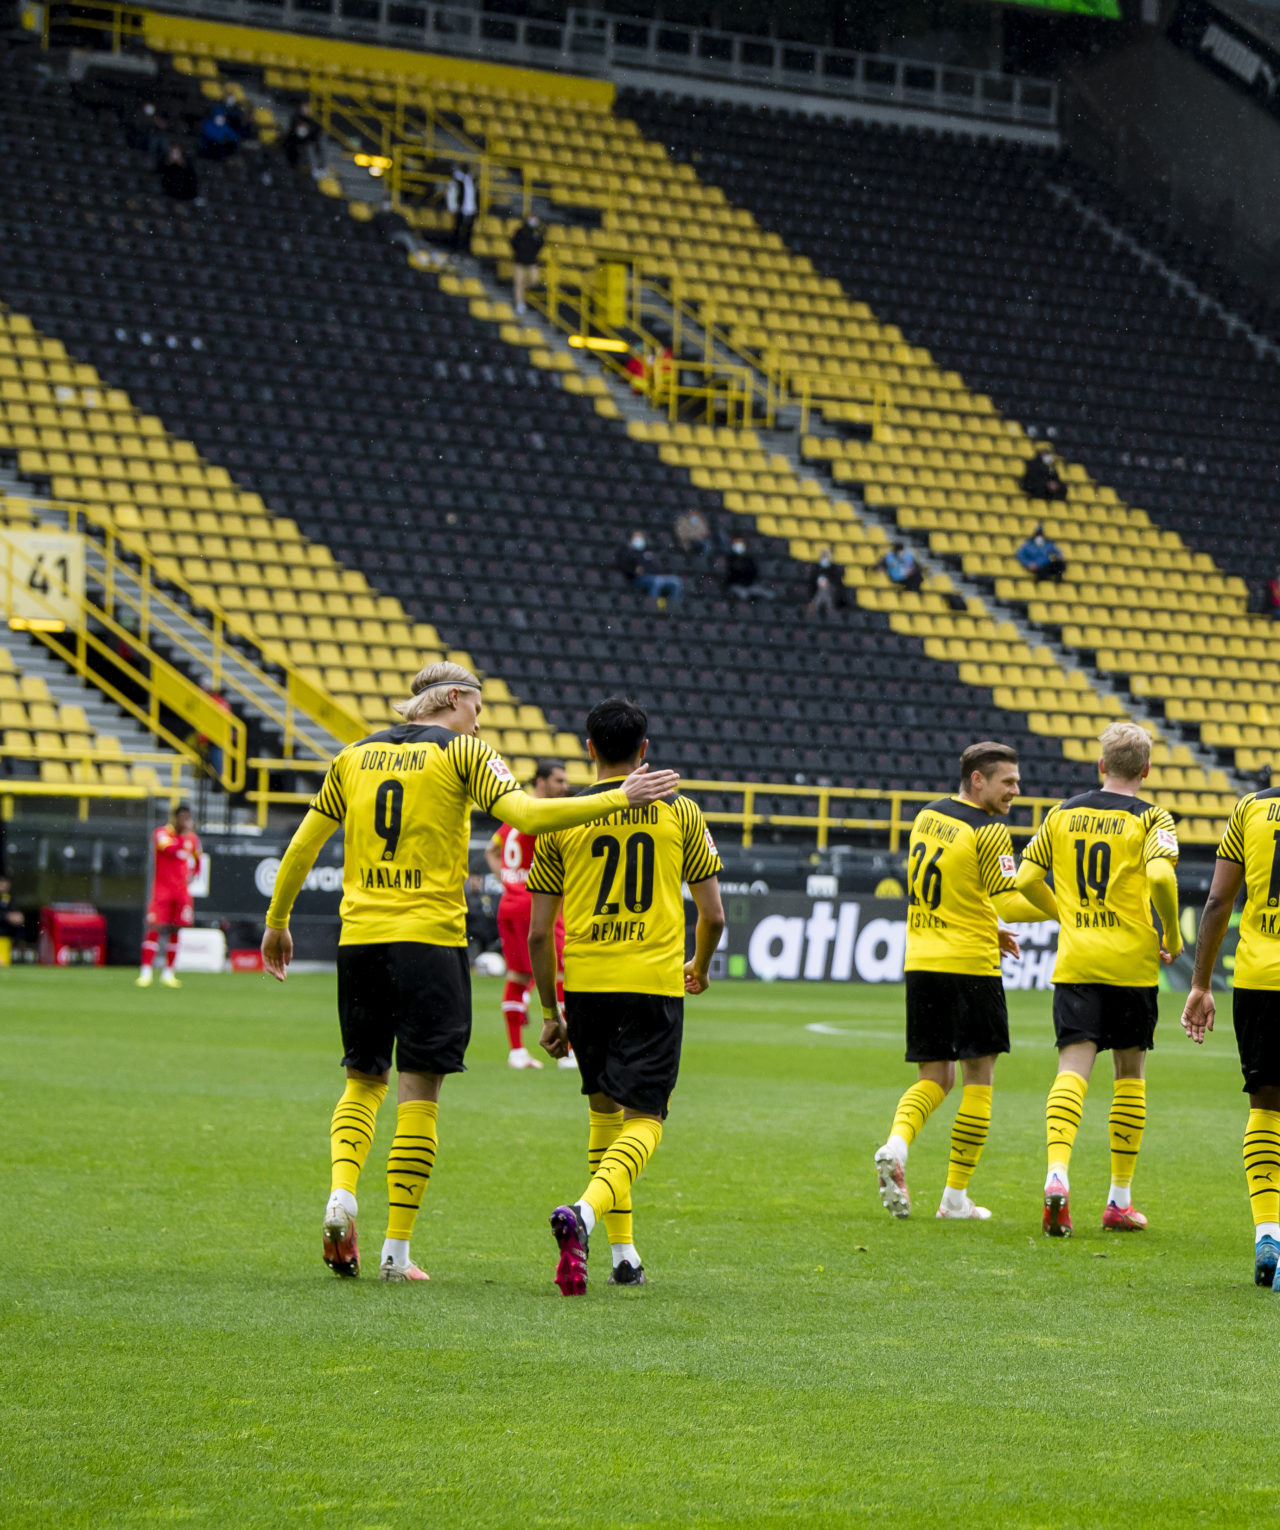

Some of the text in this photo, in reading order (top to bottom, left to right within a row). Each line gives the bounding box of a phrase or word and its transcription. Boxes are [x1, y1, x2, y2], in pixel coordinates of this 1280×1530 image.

[28, 553, 69, 598] 41
[360, 750, 427, 772] DORTMUND
[374, 779, 404, 862] 9
[917, 815, 960, 844] DORTMUND
[1069, 815, 1126, 835] DORTMUND
[503, 828, 523, 869] 6
[592, 832, 655, 917] 20
[908, 841, 945, 911] 26
[1074, 839, 1112, 908] 19
[748, 901, 906, 983] atla
[1076, 911, 1121, 929] BRANDT
